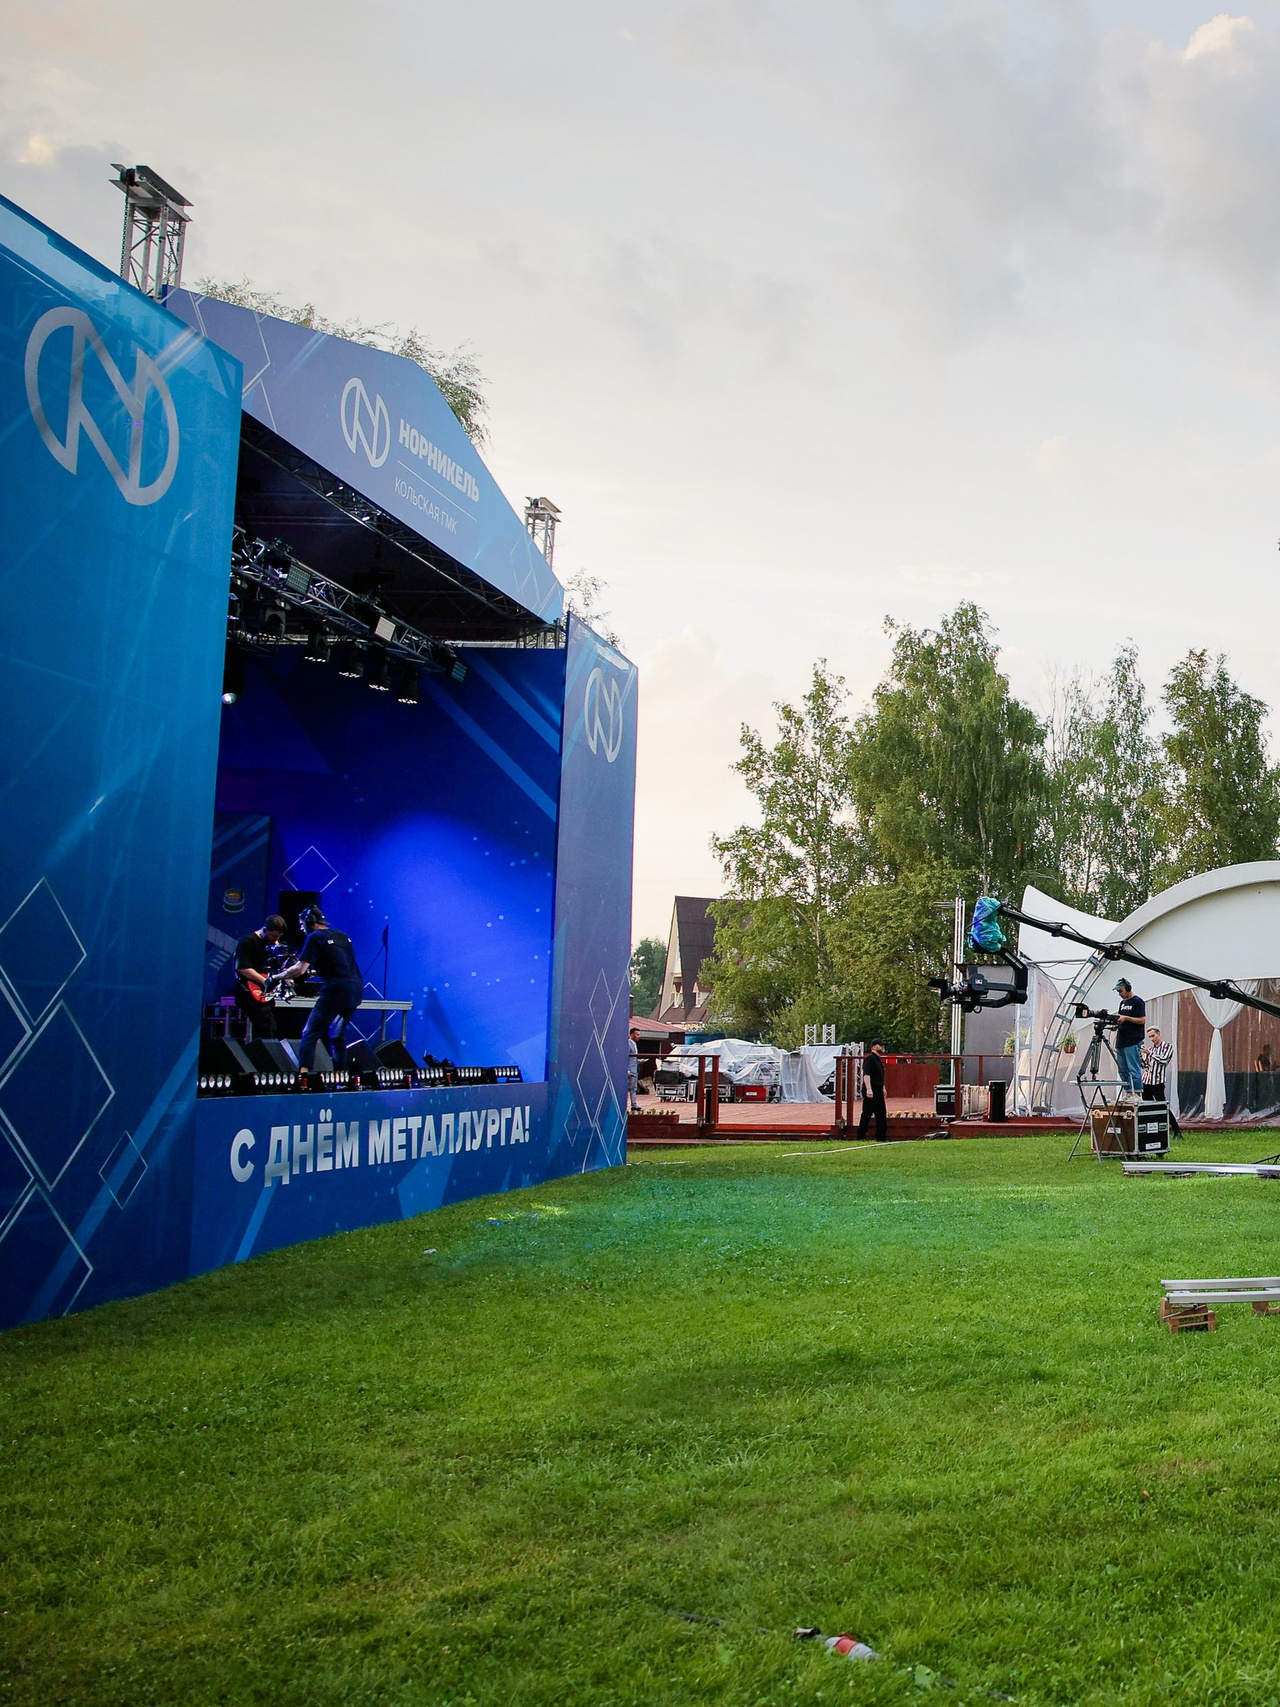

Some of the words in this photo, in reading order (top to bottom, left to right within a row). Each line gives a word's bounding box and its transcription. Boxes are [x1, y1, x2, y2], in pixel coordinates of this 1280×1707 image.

[399, 418, 480, 503] НОРНИКЕЛЬ
[394, 476, 440, 523] КОЛЬСКАЯ
[440, 510, 459, 535] ГМК
[230, 1128, 256, 1184] С
[264, 1108, 360, 1188] ДНЁМ
[367, 1105, 531, 1166] МЕТАЛЛУРГА!
